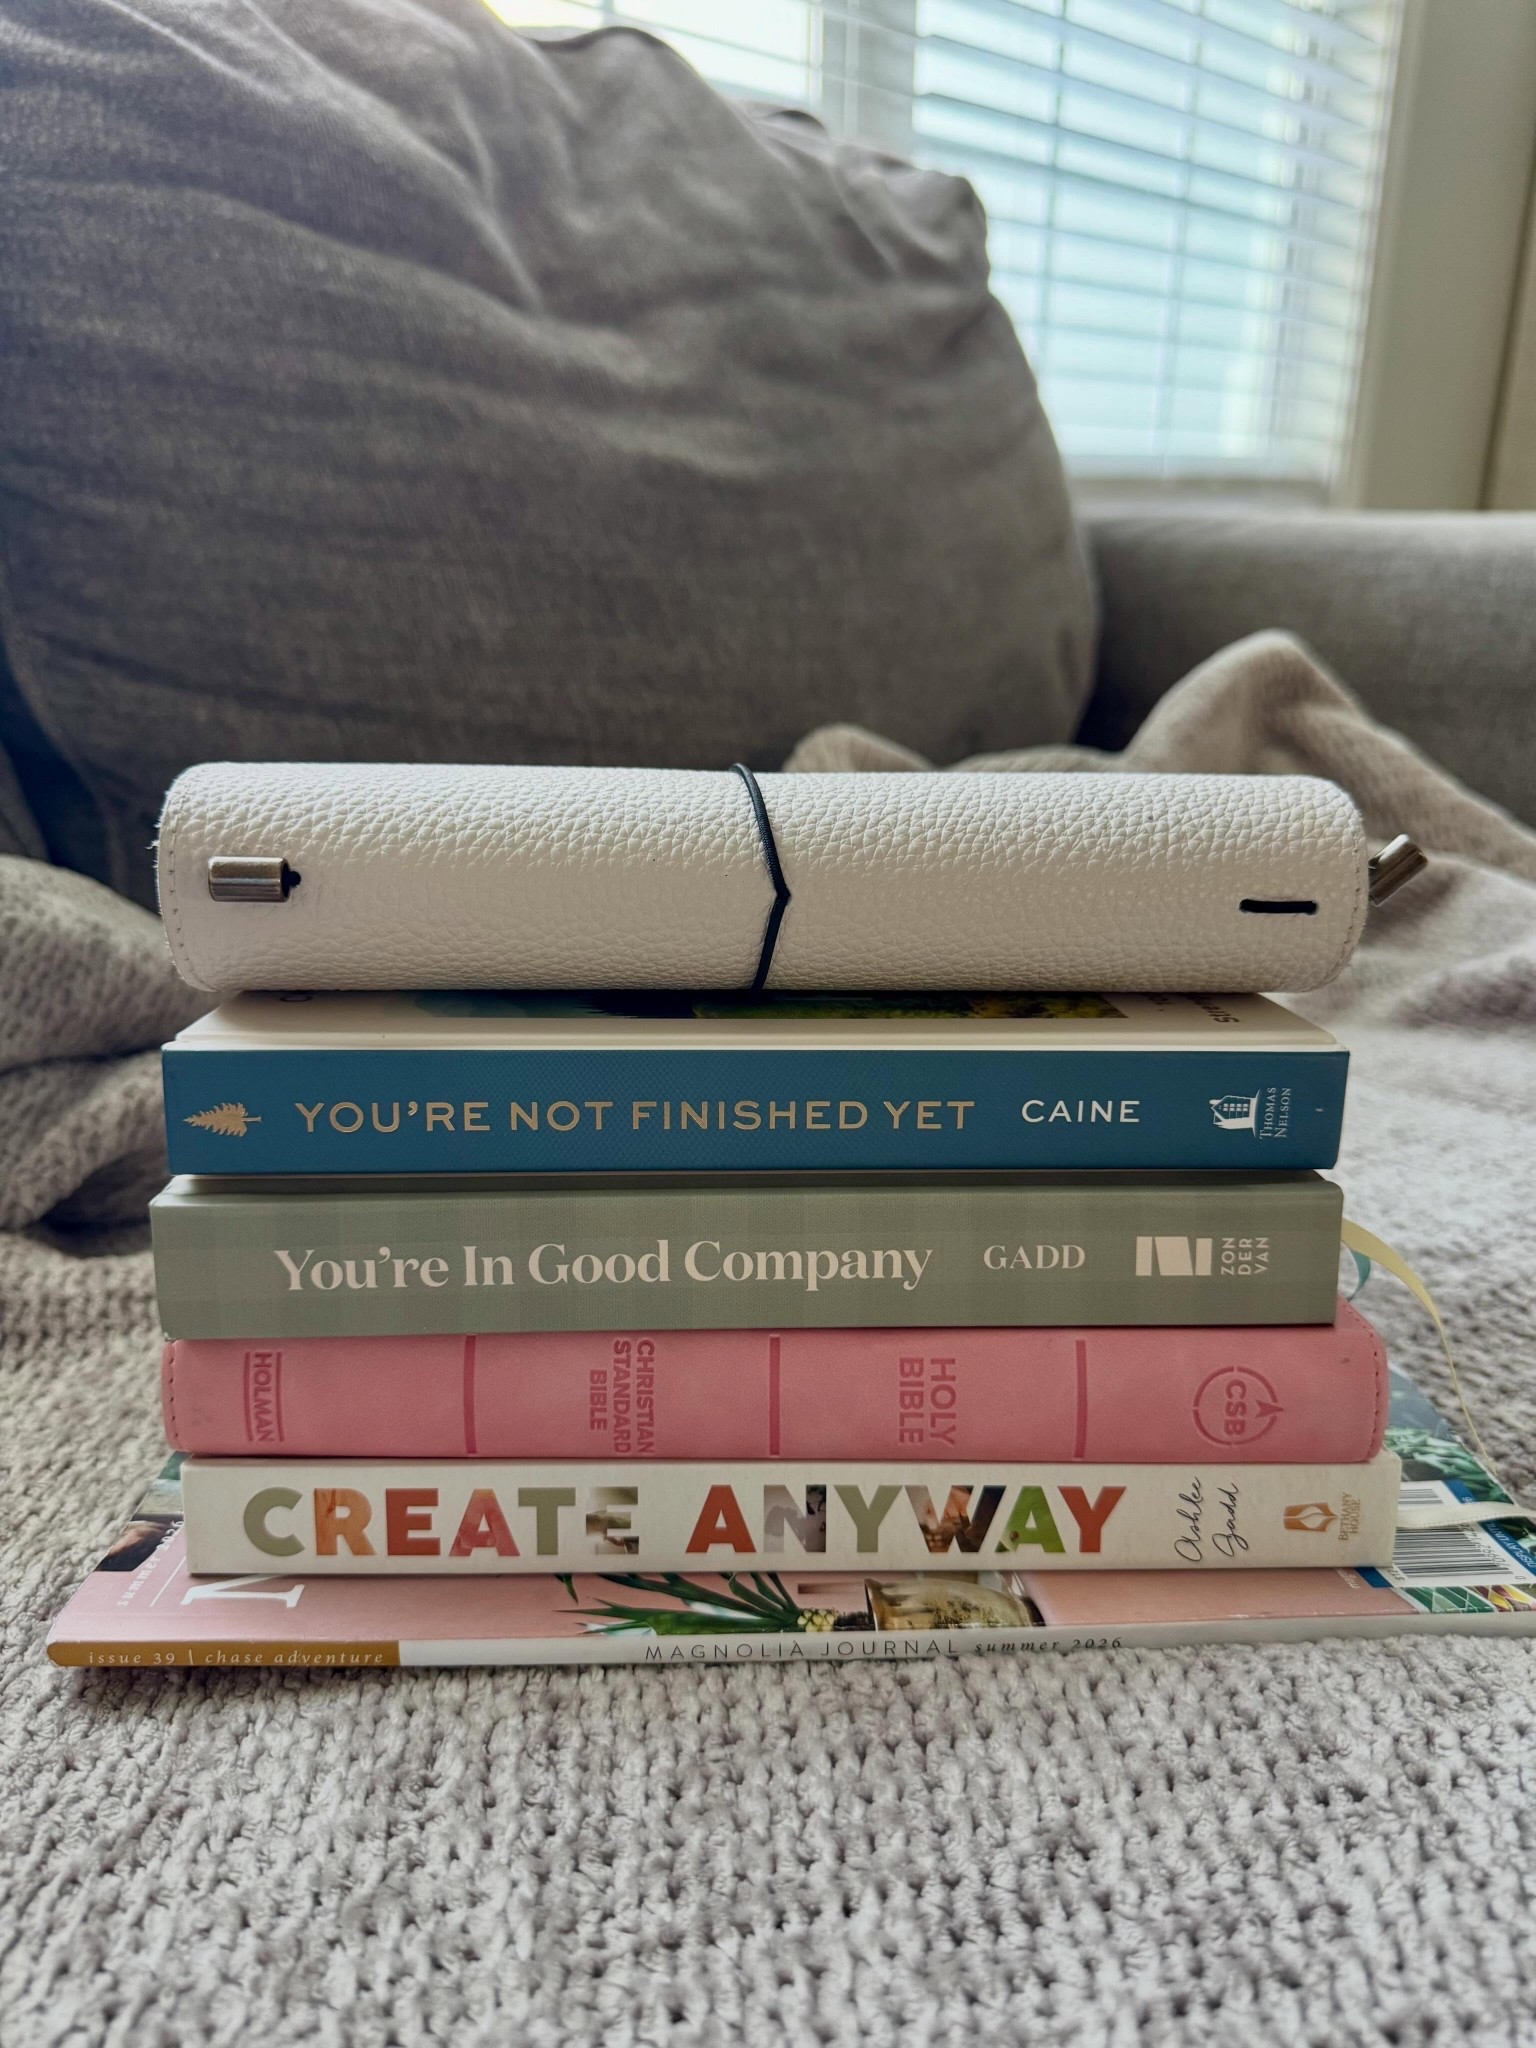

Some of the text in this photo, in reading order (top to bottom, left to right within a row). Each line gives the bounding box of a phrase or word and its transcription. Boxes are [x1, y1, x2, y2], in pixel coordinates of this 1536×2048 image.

[295, 1099, 1141, 1134] YOU'RE NOT FINISHED YET CAINE
[1259, 1087, 1276, 1139] THOMAS
[1274, 1087, 1292, 1138] NELSON
[273, 1239, 1086, 1293] You're In Good Company GADD
[1220, 1236, 1236, 1276] ZON
[1239, 1236, 1254, 1276] DER
[1256, 1235, 1270, 1275] VAN
[252, 1351, 275, 1443] HOLMAN
[588, 1368, 610, 1432] BIBLE
[612, 1338, 634, 1455] STANDARD
[637, 1338, 655, 1453] CHRISTIAN
[900, 1356, 925, 1444] BIBLE
[930, 1357, 956, 1447] HOLY
[1224, 1379, 1248, 1438] CSB
[243, 1482, 1127, 1558] CREATE ANYWAY
[1338, 1491, 1352, 1541] BETHANY
[1350, 1498, 1360, 1534] HOUSE
[89, 1650, 384, 1665] issue 39 chase adventure
[644, 1636, 1123, 1660] MAGNOLIA JOURNAL summer 2026
